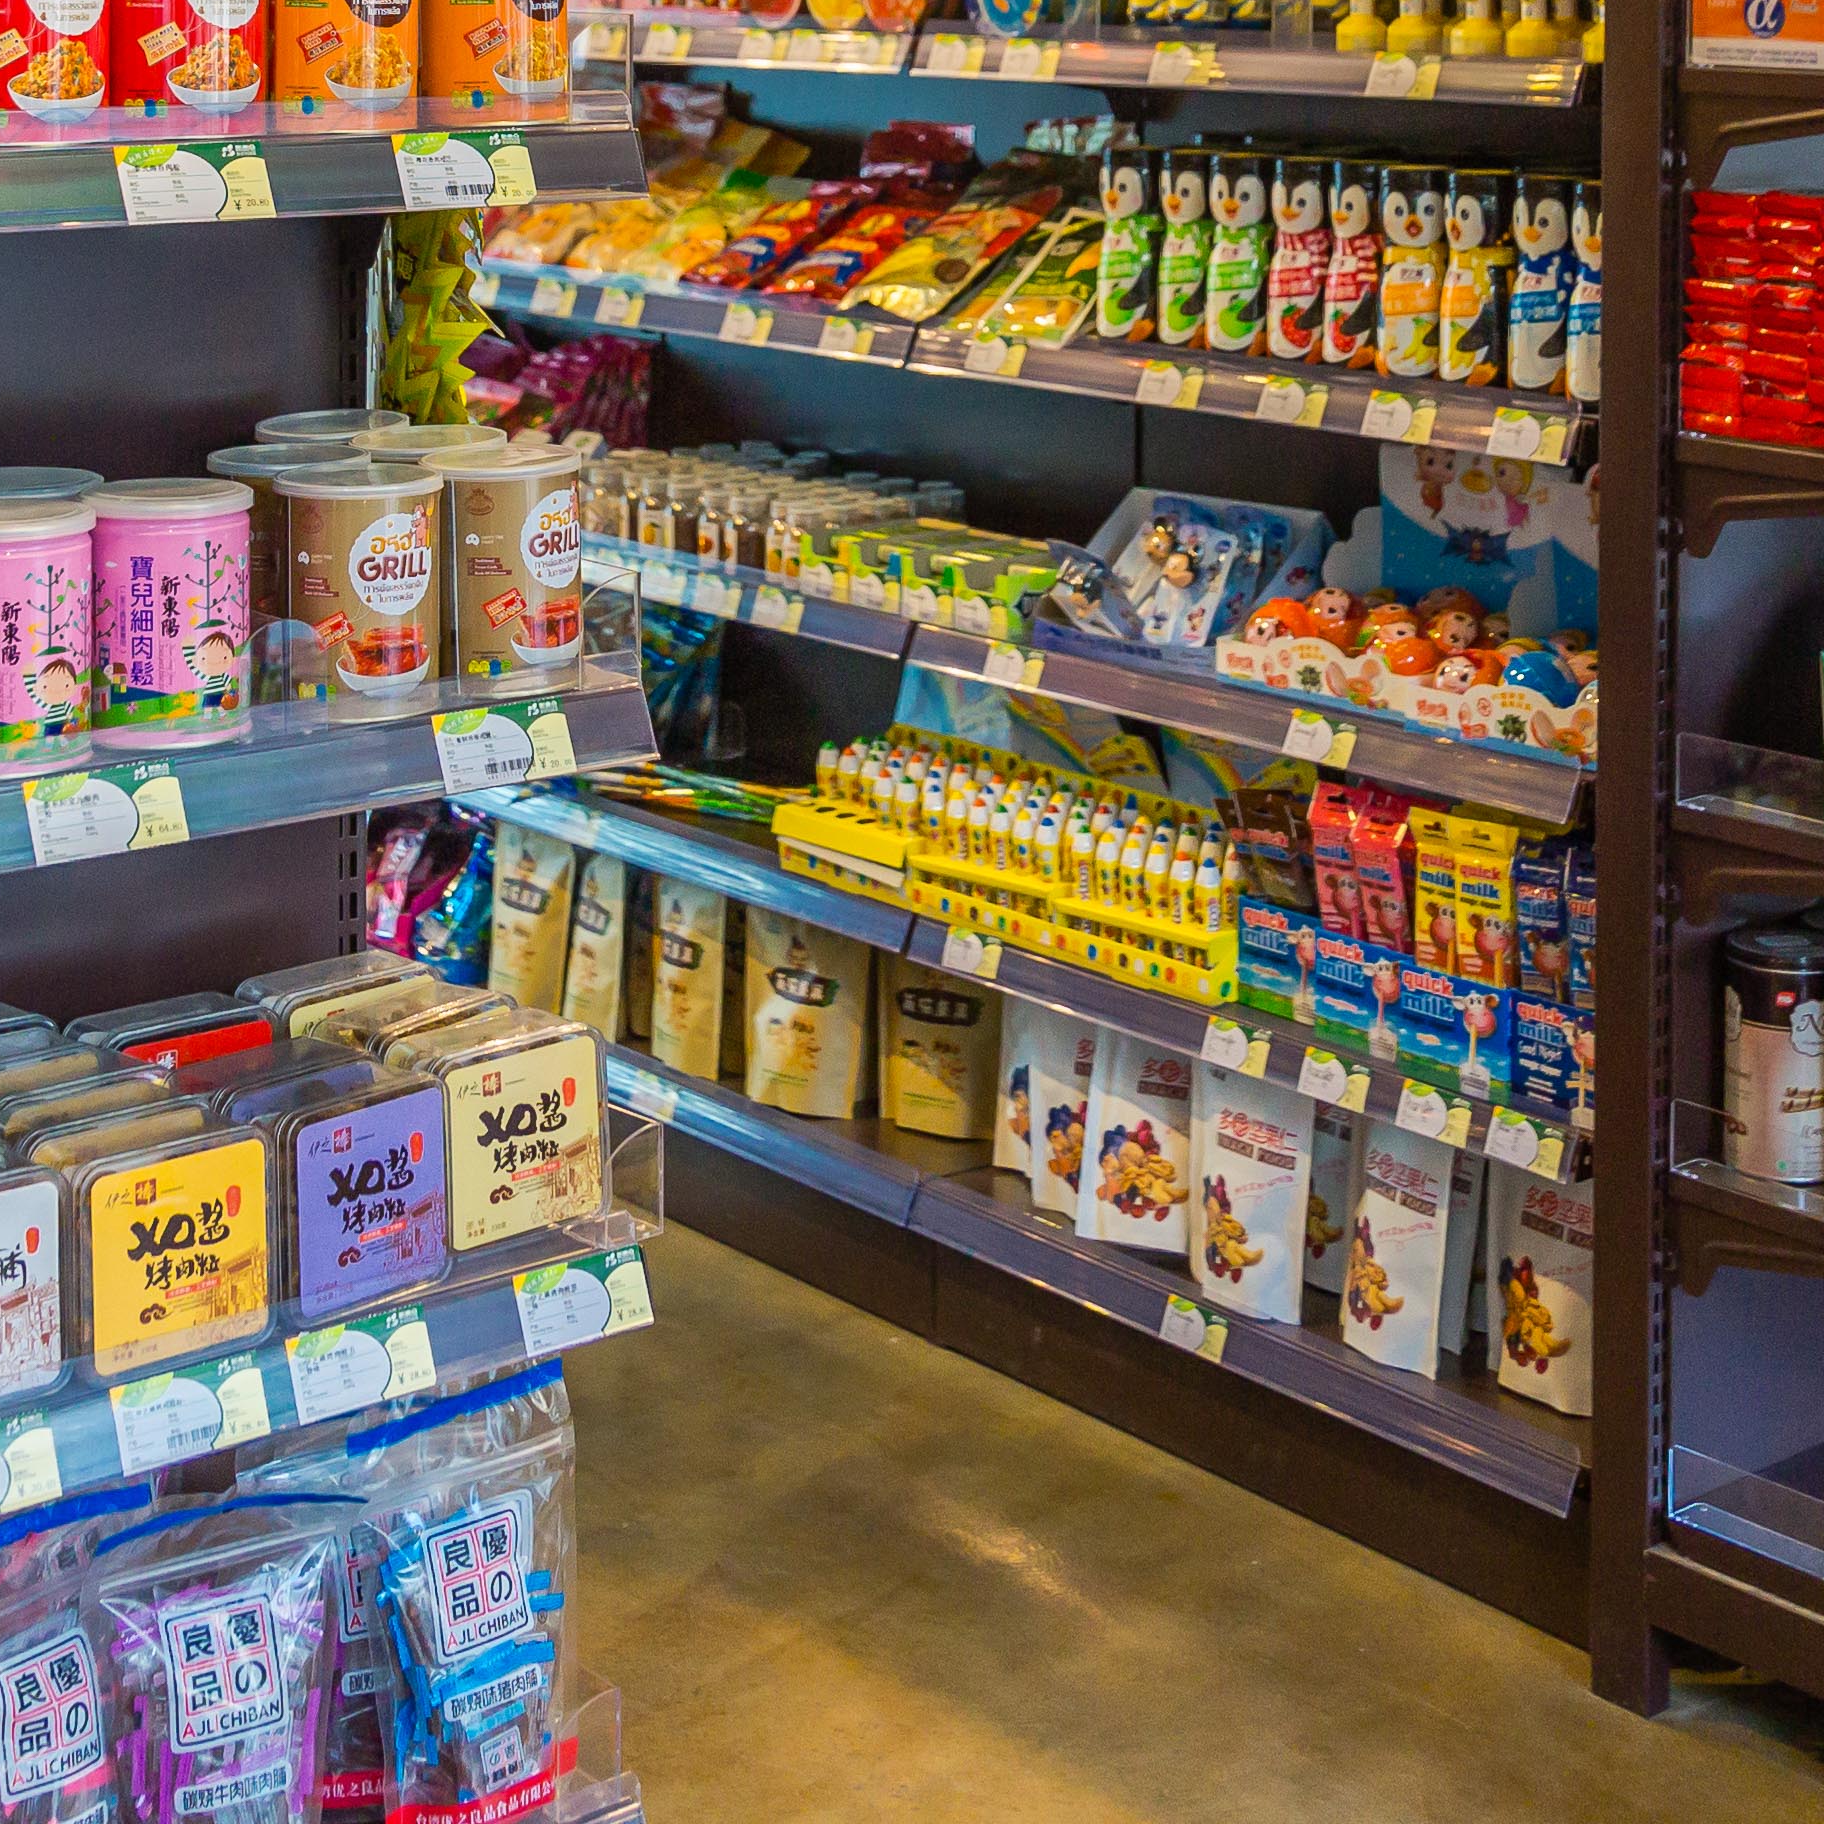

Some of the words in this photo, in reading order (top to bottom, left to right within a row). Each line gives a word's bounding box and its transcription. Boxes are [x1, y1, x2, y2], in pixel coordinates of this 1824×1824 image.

[529, 524, 579, 558] GRILL
[358, 549, 428, 582] GRILL
[130, 555, 154, 686] 寶兒細肉鬆
[160, 575, 181, 639] 新東陽
[1, 601, 23, 666] 新東陽
[1317, 937, 1364, 963] quick
[1403, 970, 1454, 997] quick
